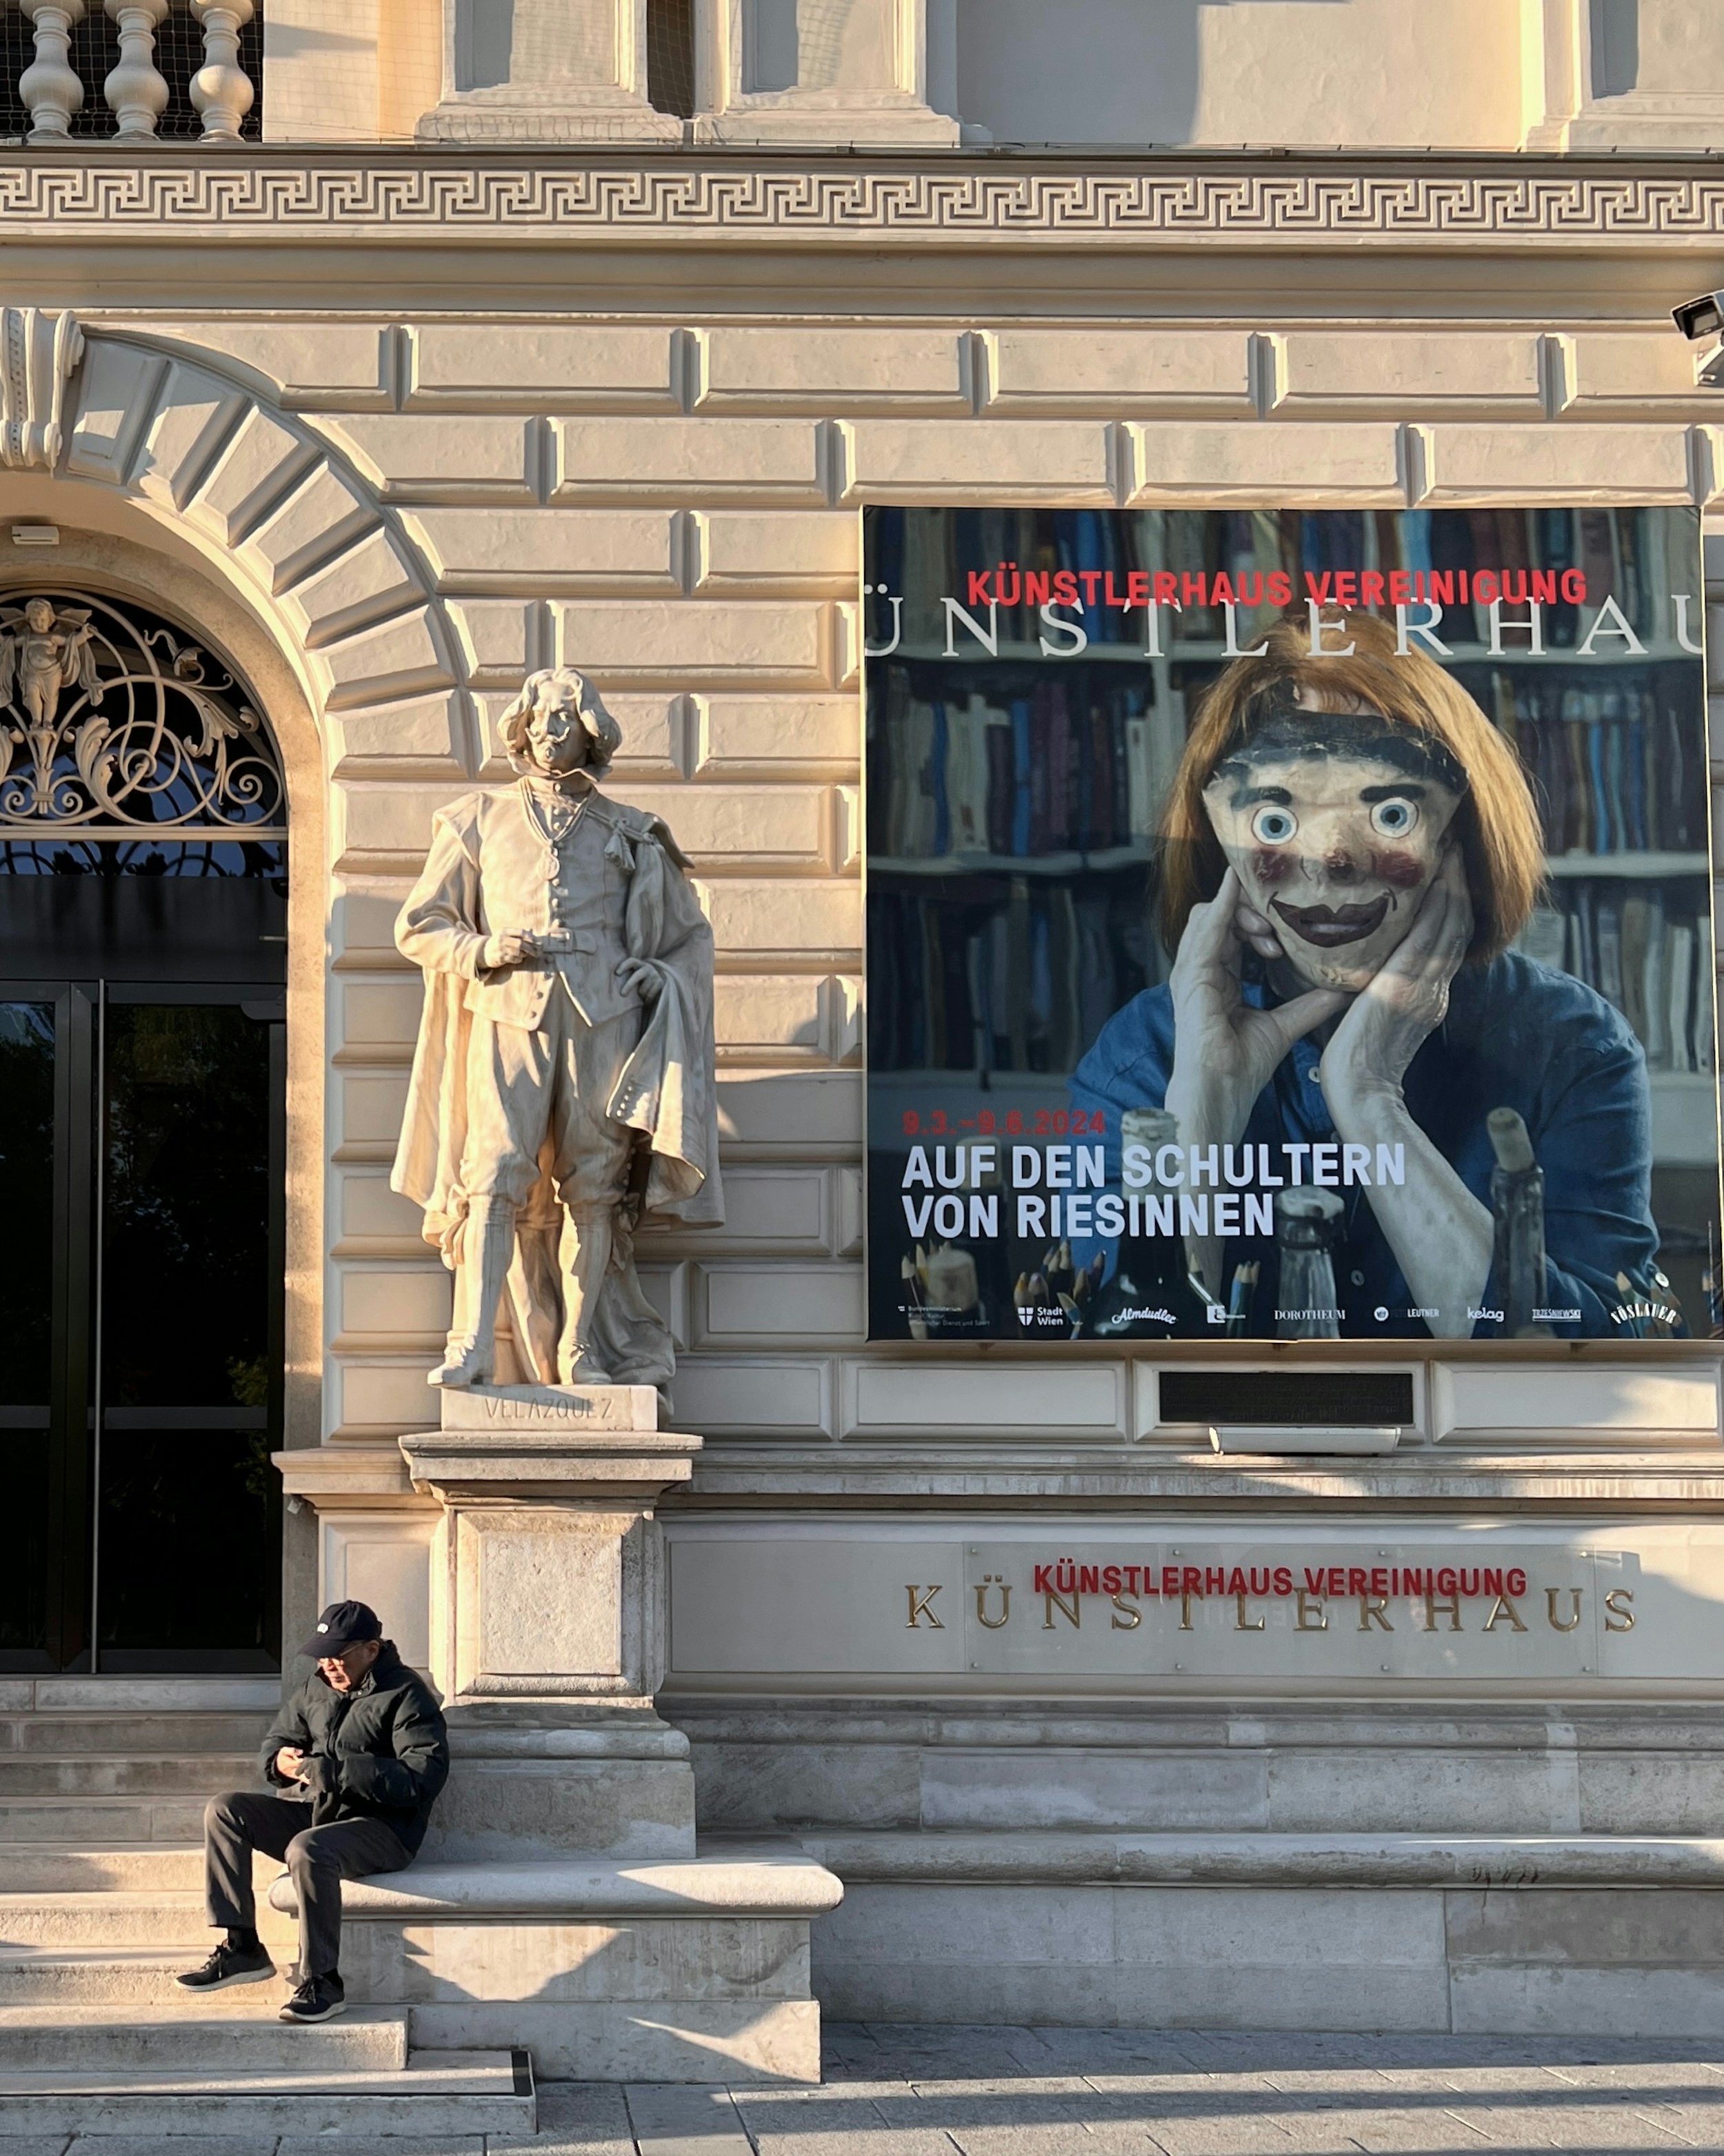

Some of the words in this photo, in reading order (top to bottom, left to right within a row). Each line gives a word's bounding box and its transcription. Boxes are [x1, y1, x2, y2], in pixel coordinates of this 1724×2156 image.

[968, 562, 1292, 607] KÜNSTLERHAUS
[1305, 568, 1587, 606] VEREINIGUNG
[901, 1145, 996, 1189] AUF
[1012, 1145, 1105, 1188] DEN
[1122, 1143, 1405, 1188] SCHULTERN
[901, 1195, 999, 1239] VON
[1017, 1192, 1274, 1239] RIESINNEN
[1037, 1306, 1063, 1316] Stadt
[1037, 1316, 1064, 1326] Wien
[1111, 1307, 1176, 1324] Almdudler
[1274, 1309, 1345, 1320] DOROTHEUM
[1467, 1306, 1505, 1322] kelag
[1610, 1303, 1677, 1324] VÖSLAUER
[485, 1397, 615, 1420] VELAZQUEZ
[1034, 1558, 1293, 1596] KÜNSTLERHAUS
[1305, 1568, 1527, 1597] VEREINIGUNG
[905, 1575, 1636, 1633] KÜNSTLERHAUS
